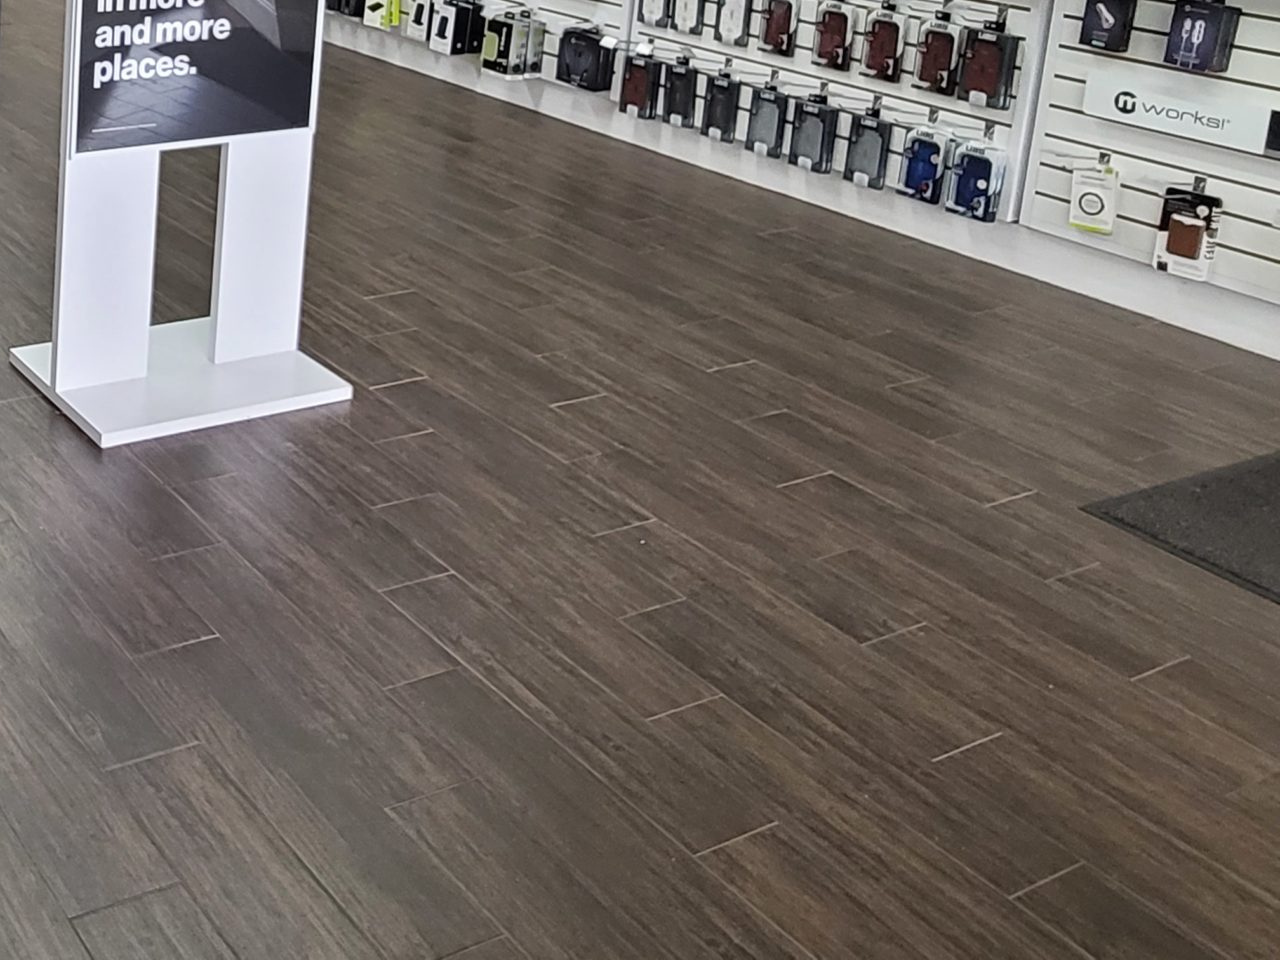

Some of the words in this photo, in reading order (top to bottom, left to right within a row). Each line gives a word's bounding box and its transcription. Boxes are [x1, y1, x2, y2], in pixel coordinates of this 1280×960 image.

[95, 16, 152, 48] and
[156, 17, 231, 43] more
[93, 53, 197, 89] places.
